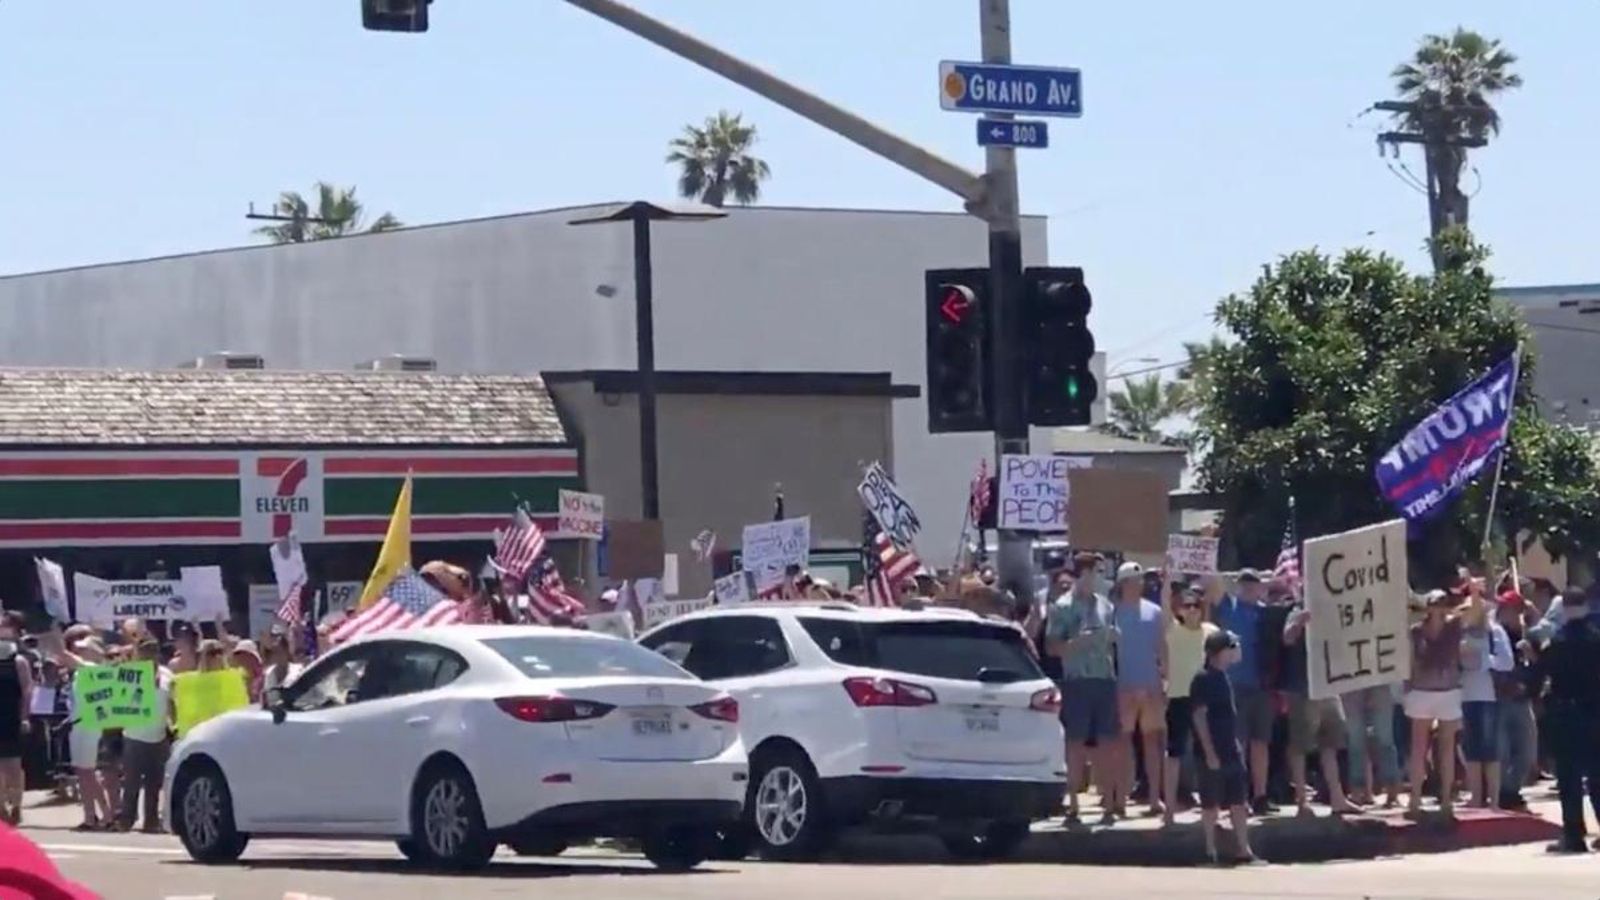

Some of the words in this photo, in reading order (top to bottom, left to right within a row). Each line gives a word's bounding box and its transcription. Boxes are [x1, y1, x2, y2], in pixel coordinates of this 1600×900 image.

[969, 74, 1037, 104] GRAND
[1012, 125, 1037, 143] 800
[257, 457, 308, 538] 7
[1002, 498, 1068, 526] PEOP
[1322, 533, 1389, 595] Covid
[110, 584, 174, 597] FREEDOM
[113, 603, 168, 616] LIBERTY
[1362, 598, 1374, 623] A
[1324, 633, 1395, 685] LIE
[118, 668, 144, 684] NOT
